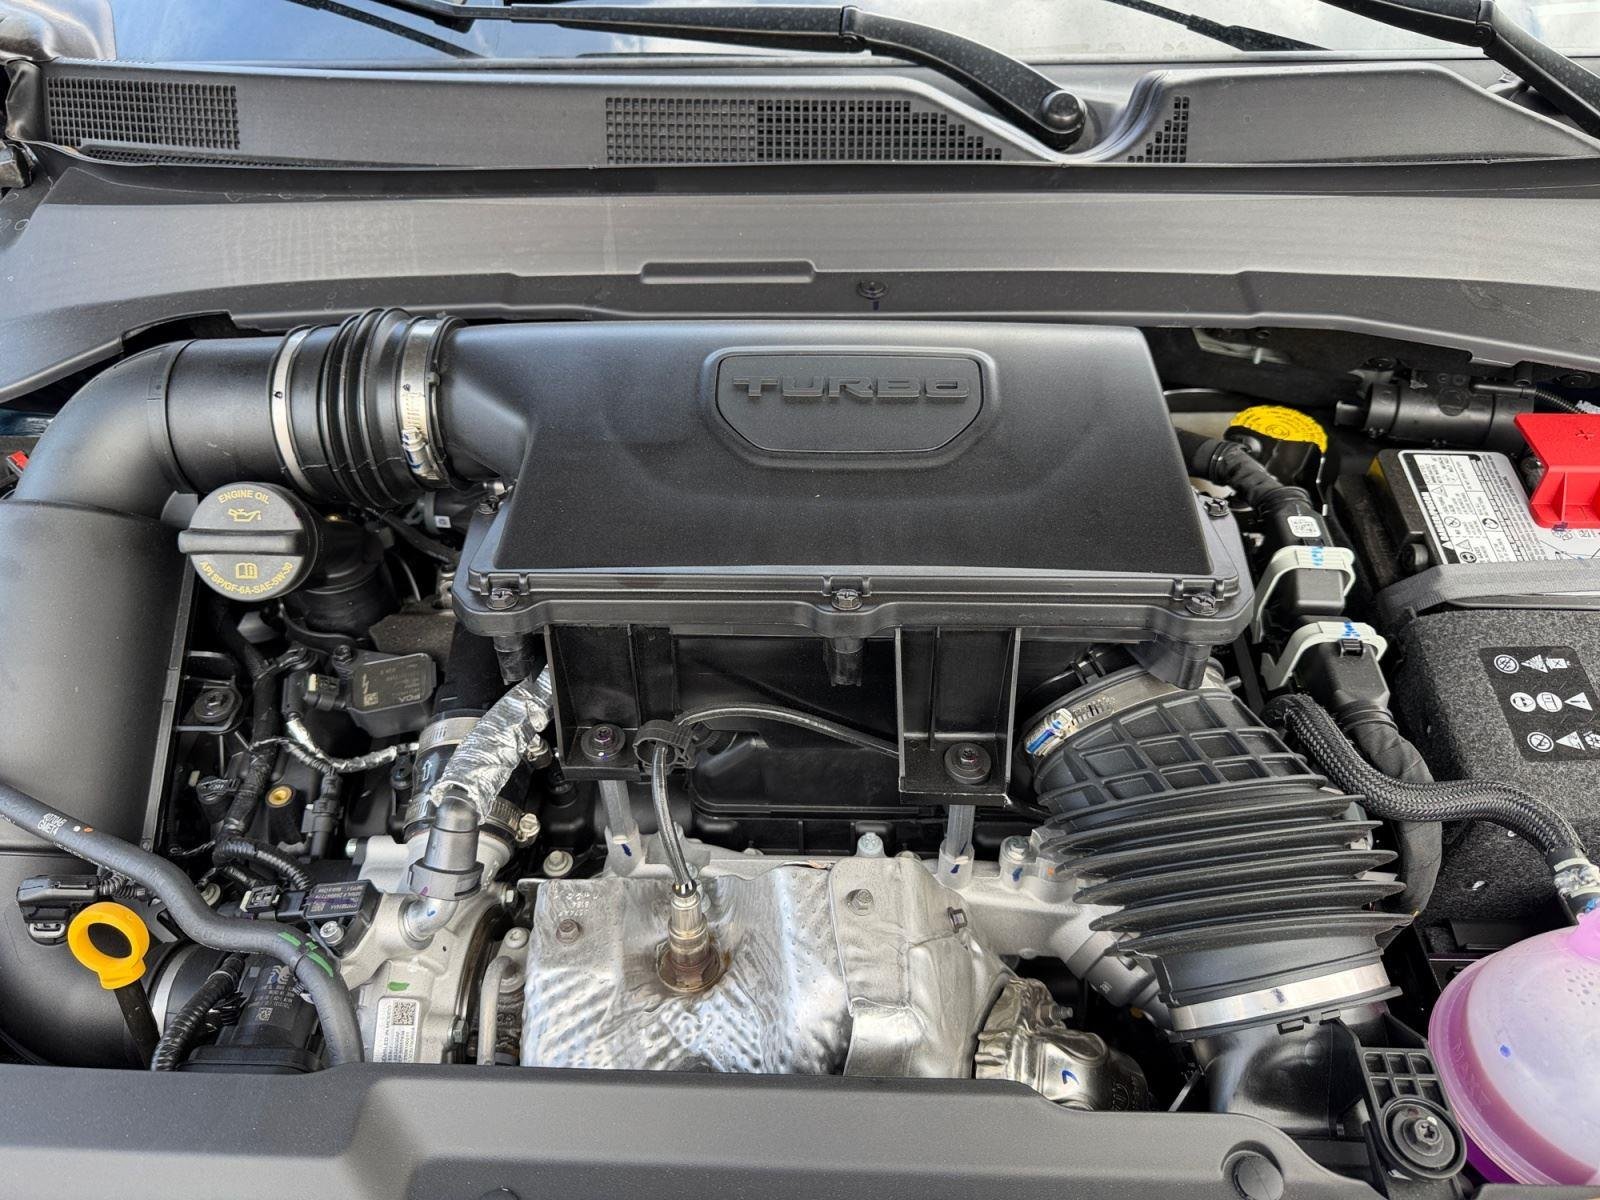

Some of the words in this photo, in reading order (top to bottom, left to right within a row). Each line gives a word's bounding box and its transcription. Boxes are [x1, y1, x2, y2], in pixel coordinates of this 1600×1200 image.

[733, 376, 969, 398] TURBO
[218, 489, 254, 504] ENGINE
[254, 491, 269, 504] OIL
[200, 560, 213, 577] API
